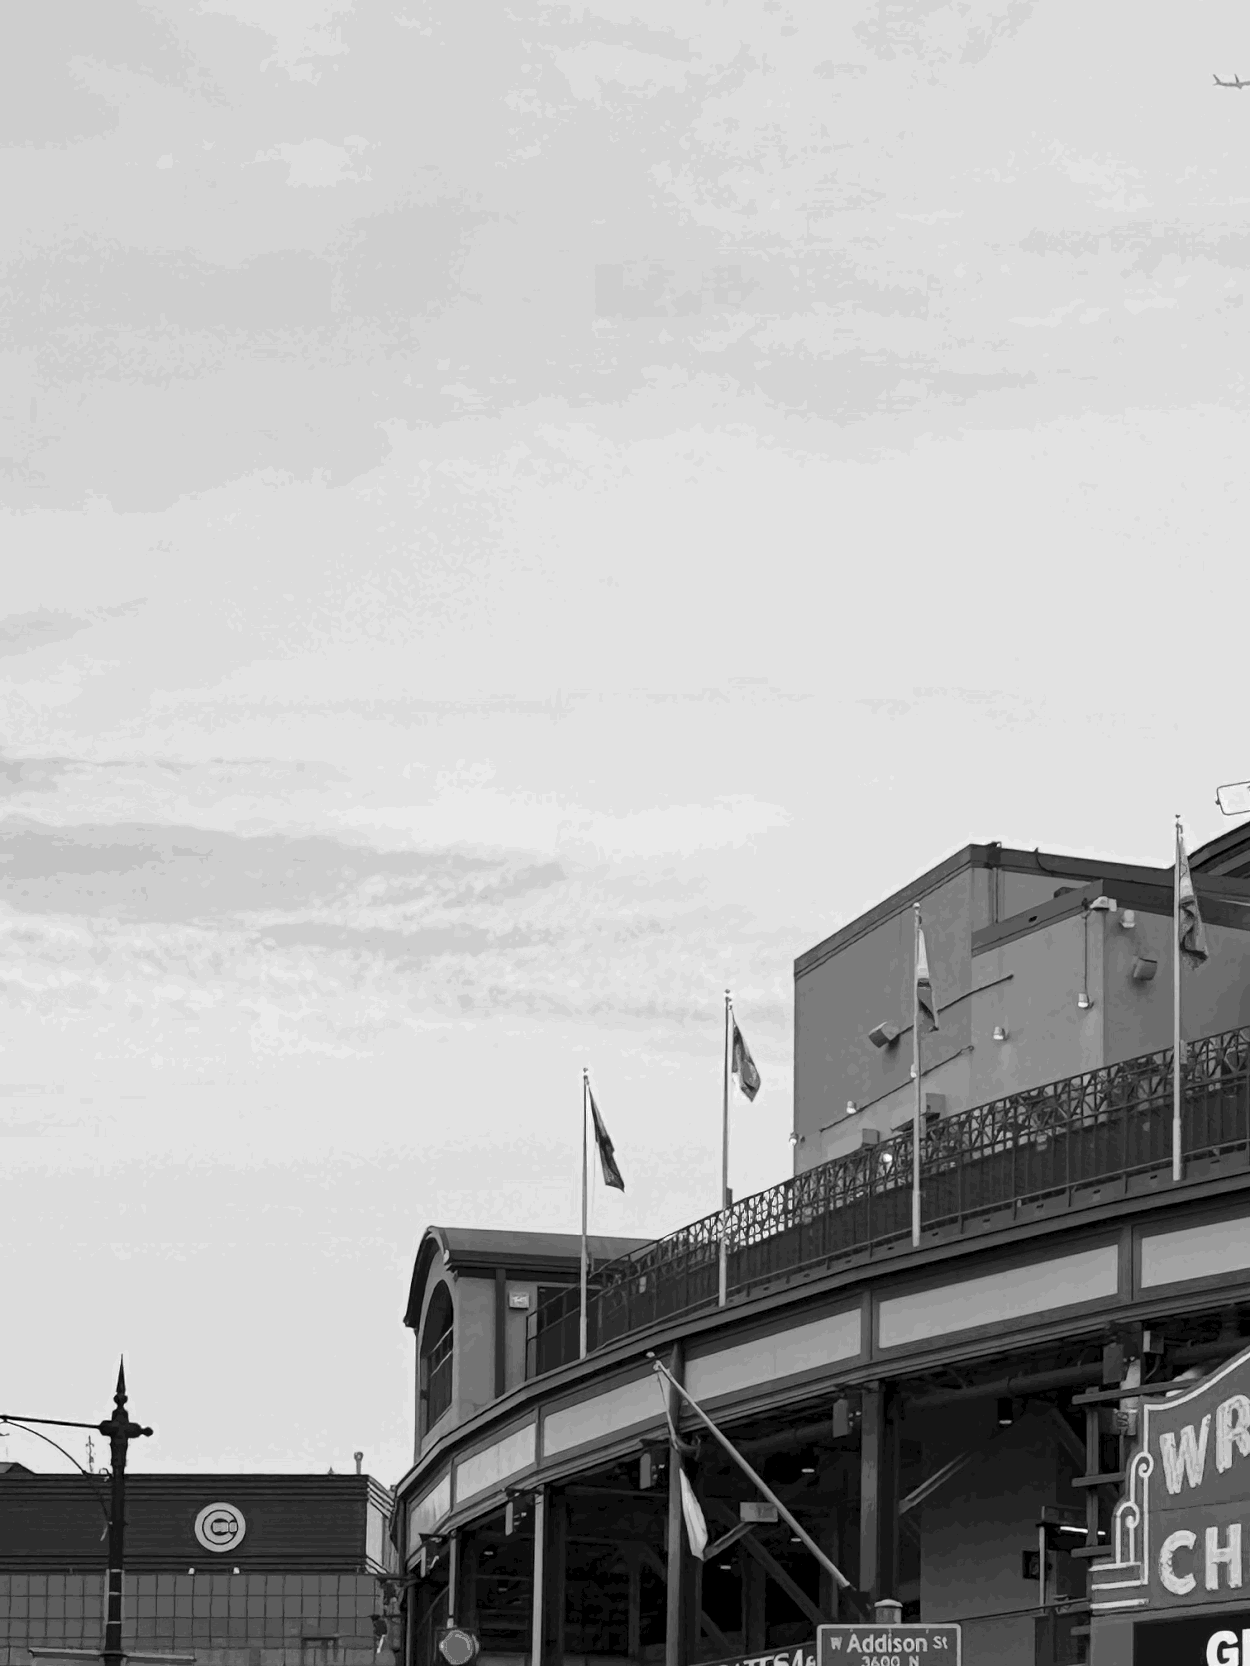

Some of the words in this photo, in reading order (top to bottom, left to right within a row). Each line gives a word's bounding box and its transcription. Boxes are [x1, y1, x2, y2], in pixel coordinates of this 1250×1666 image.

[830, 1636, 843, 1651] W
[847, 1634, 928, 1653] Addison
[933, 1635, 949, 1650] St
